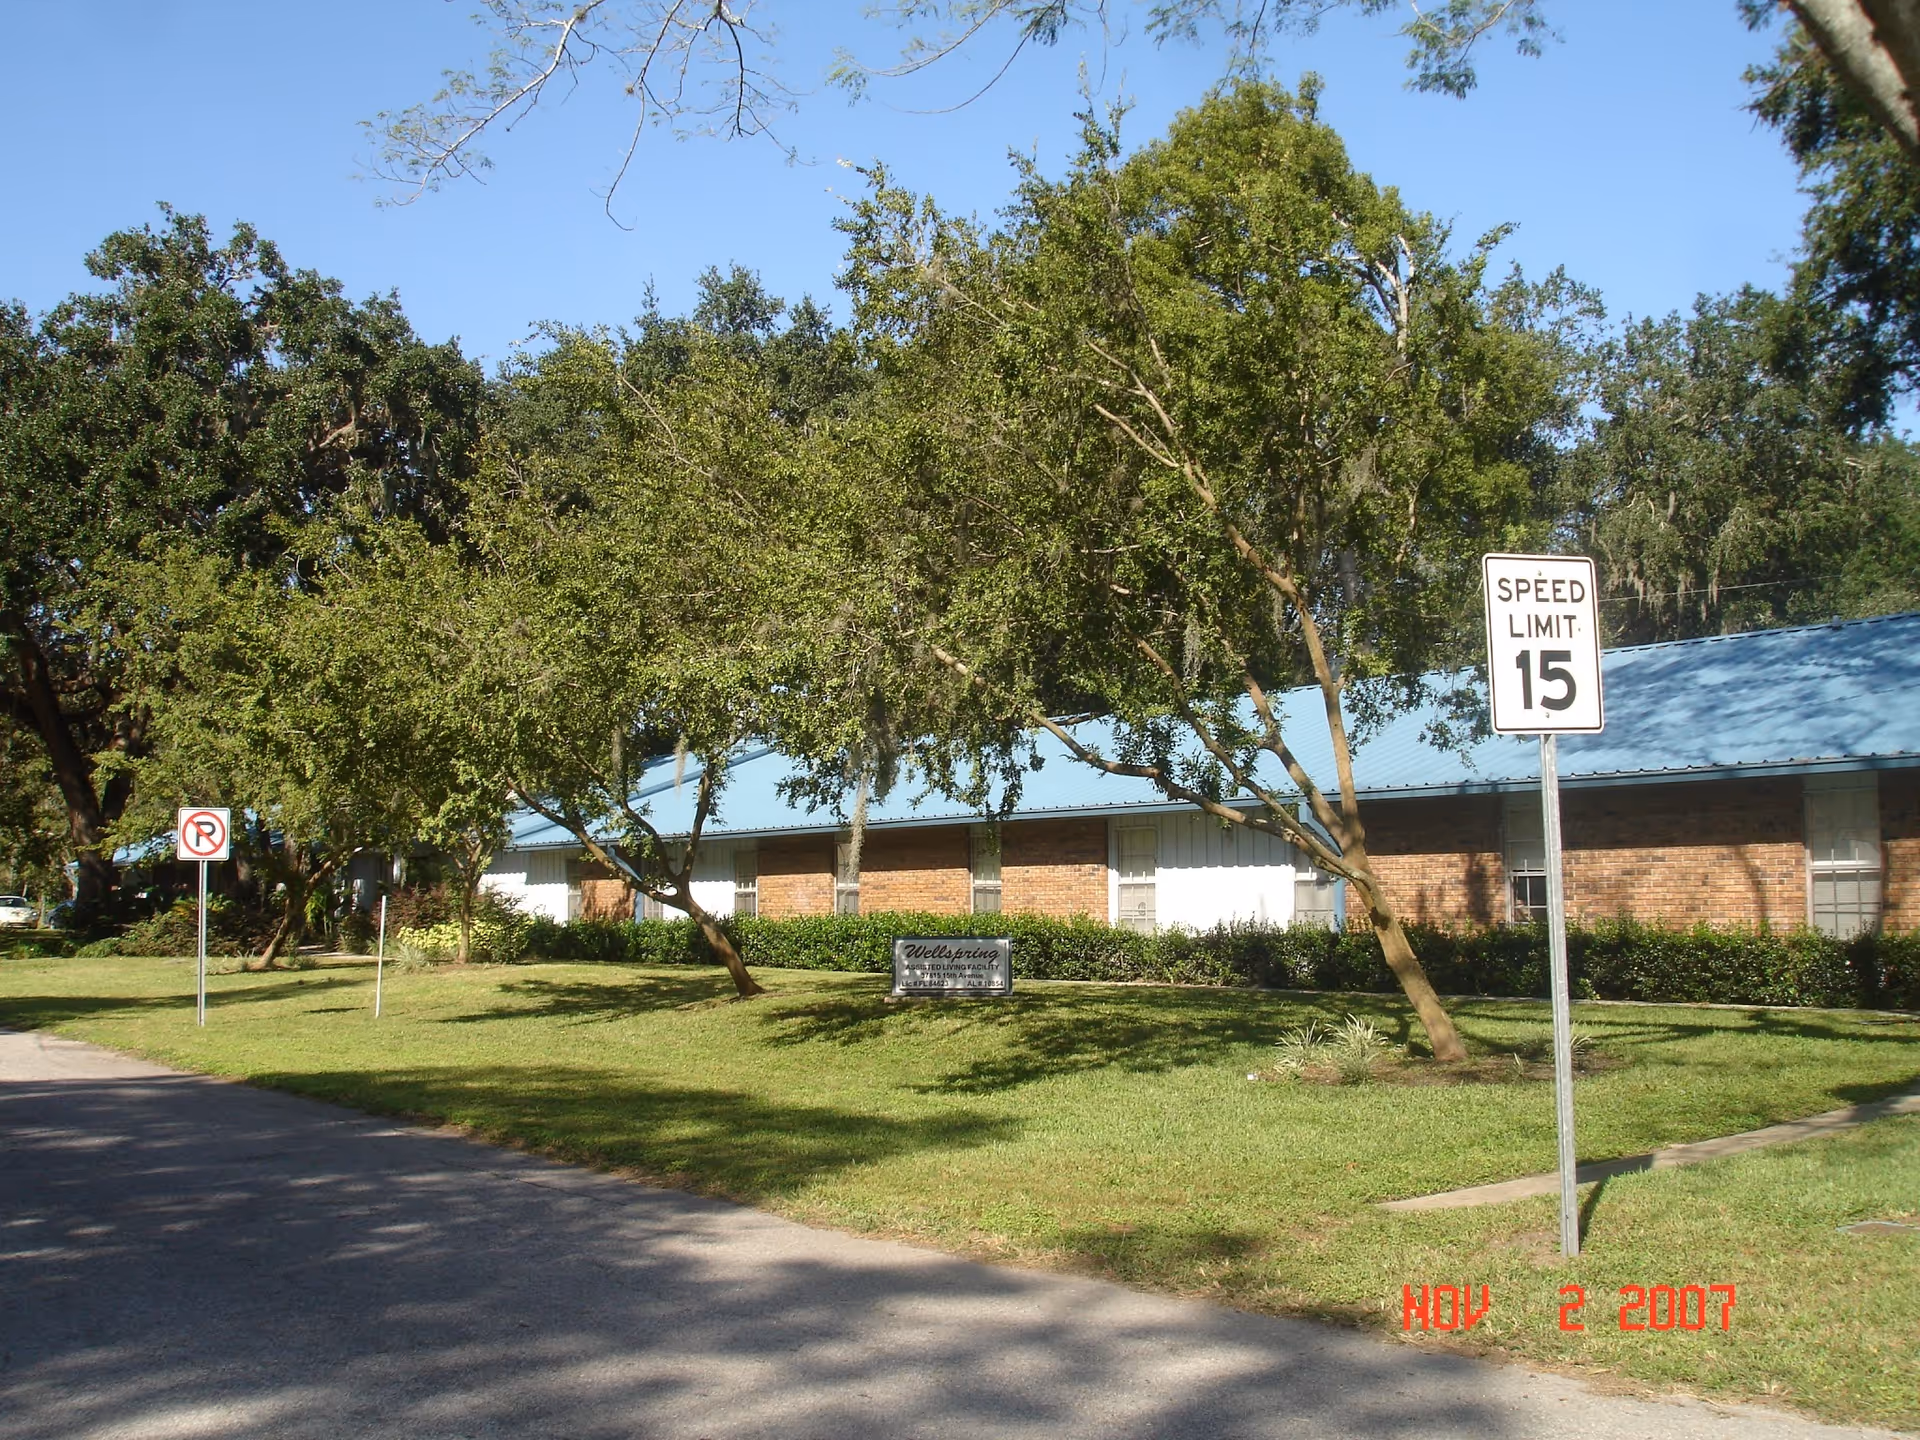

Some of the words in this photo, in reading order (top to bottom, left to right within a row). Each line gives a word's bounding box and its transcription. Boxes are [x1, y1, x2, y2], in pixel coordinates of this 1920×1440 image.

[1497, 577, 1585, 603] SPEED
[1509, 614, 1577, 638] LIMIT
[1515, 649, 1577, 711] 15
[195, 821, 216, 847] P
[904, 944, 1000, 964] Wellspring
[905, 963, 941, 971] ASSISTED
[942, 963, 967, 971] LIVING
[967, 963, 1000, 971] FACILITY
